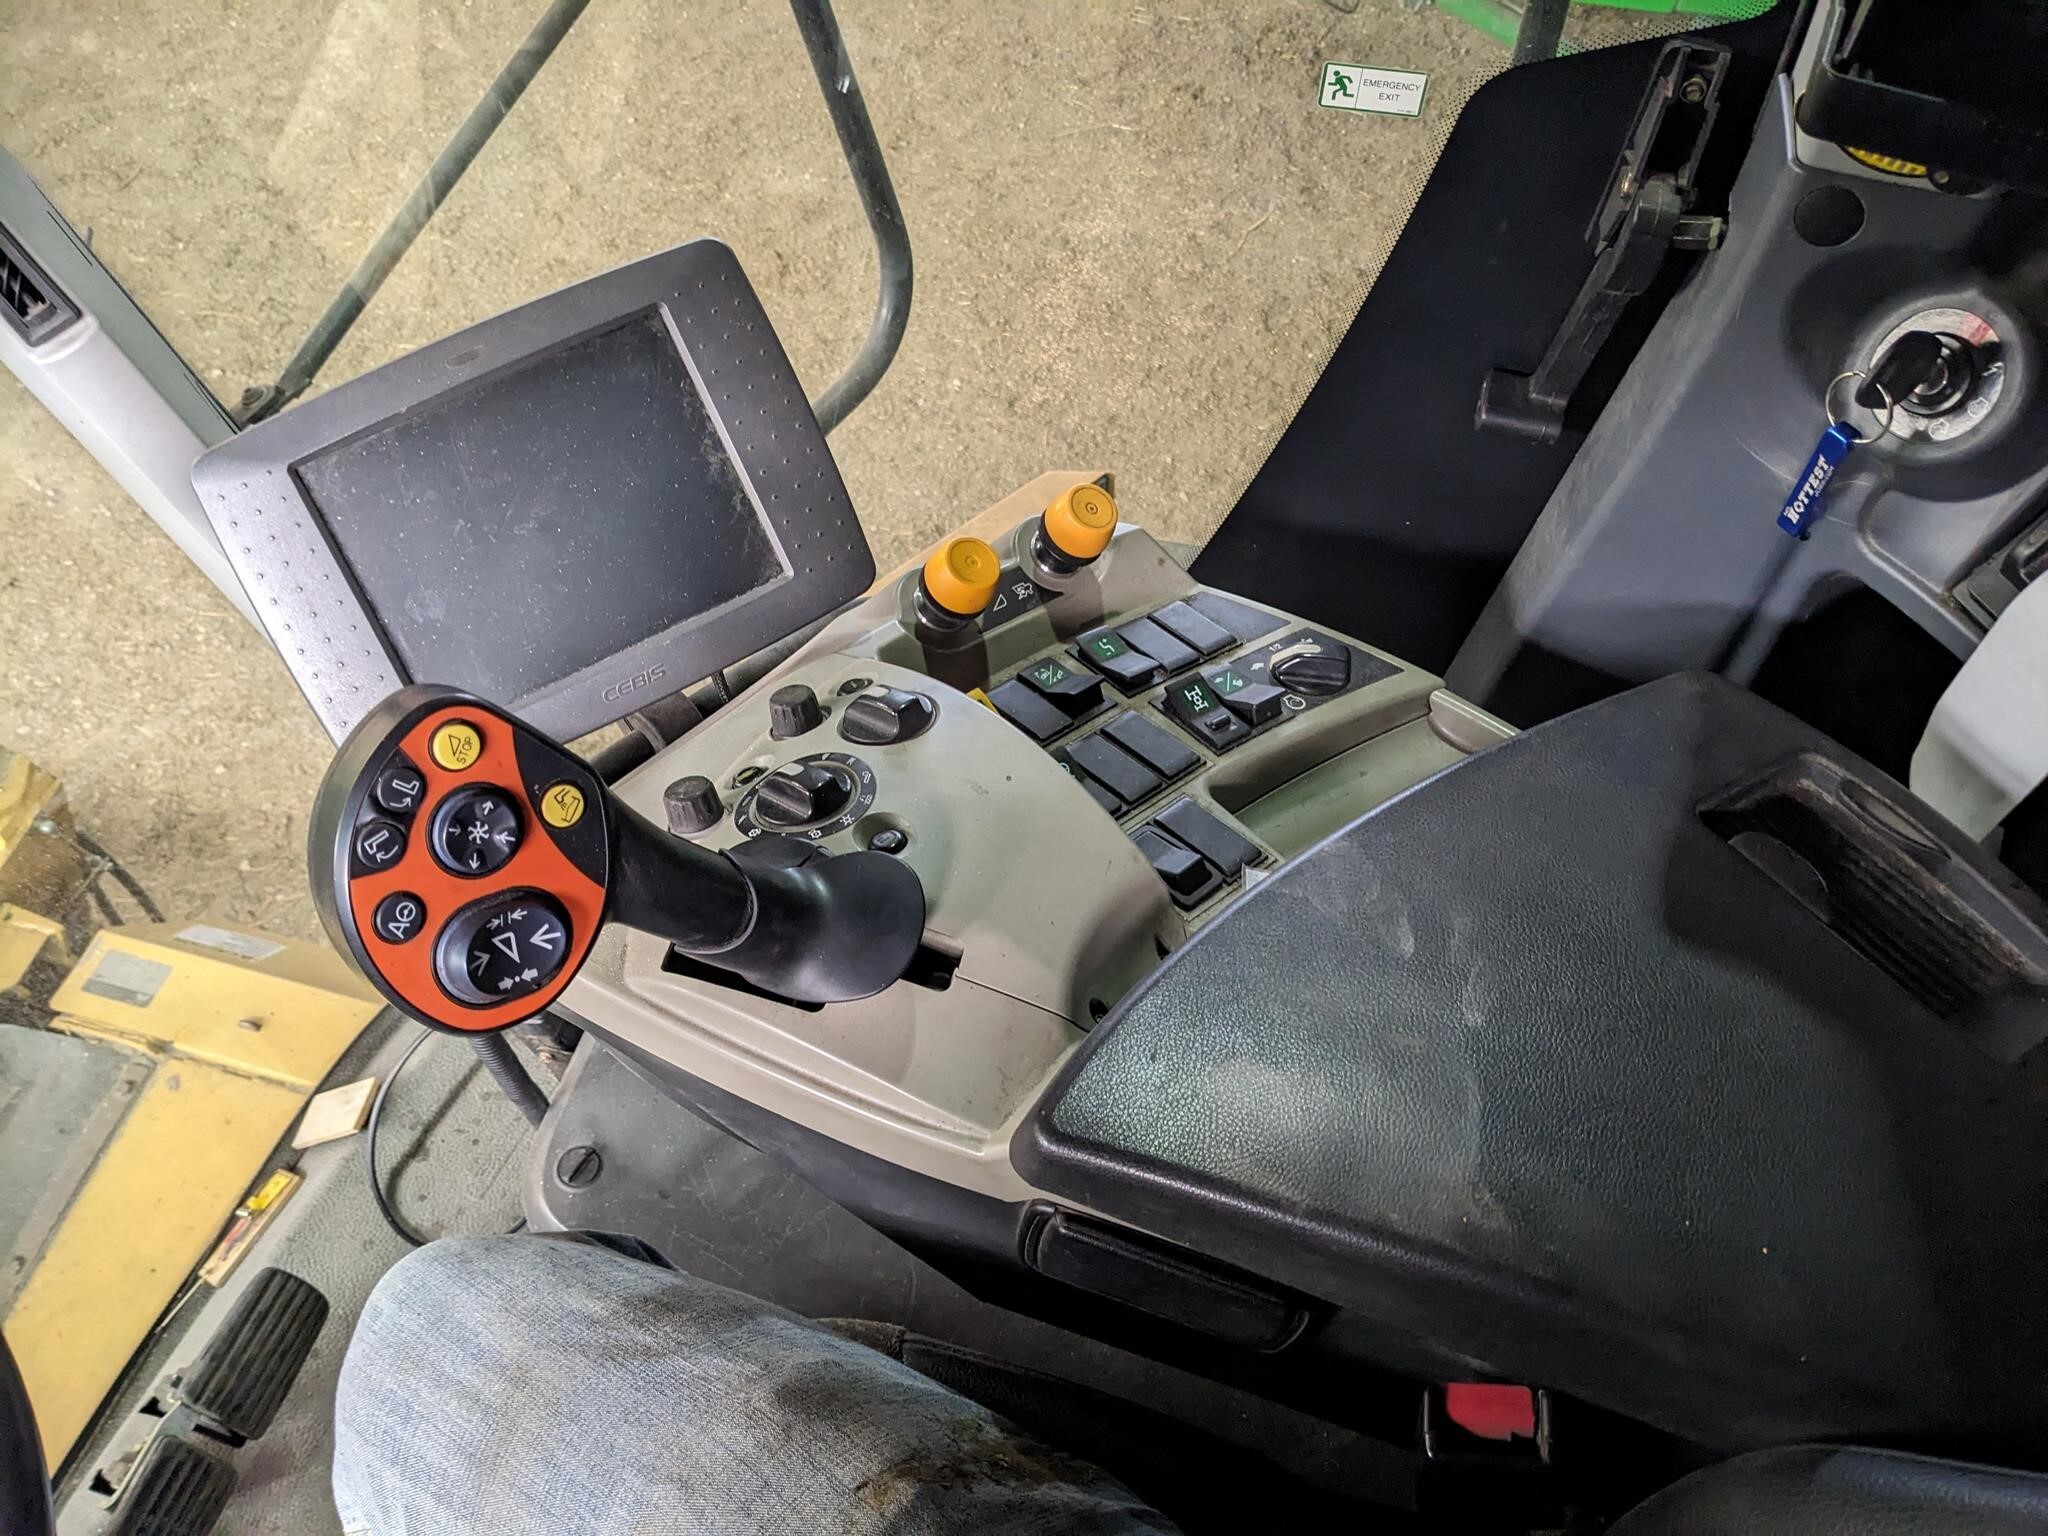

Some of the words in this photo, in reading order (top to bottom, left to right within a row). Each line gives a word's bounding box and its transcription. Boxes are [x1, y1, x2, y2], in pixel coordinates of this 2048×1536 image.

[1362, 78, 1421, 92] EMERGENCY
[1378, 92, 1401, 102] EXIT
[1785, 453, 1829, 524] HOTTEST
[602, 661, 666, 703] CEBIS
[456, 736, 473, 764] STOP
